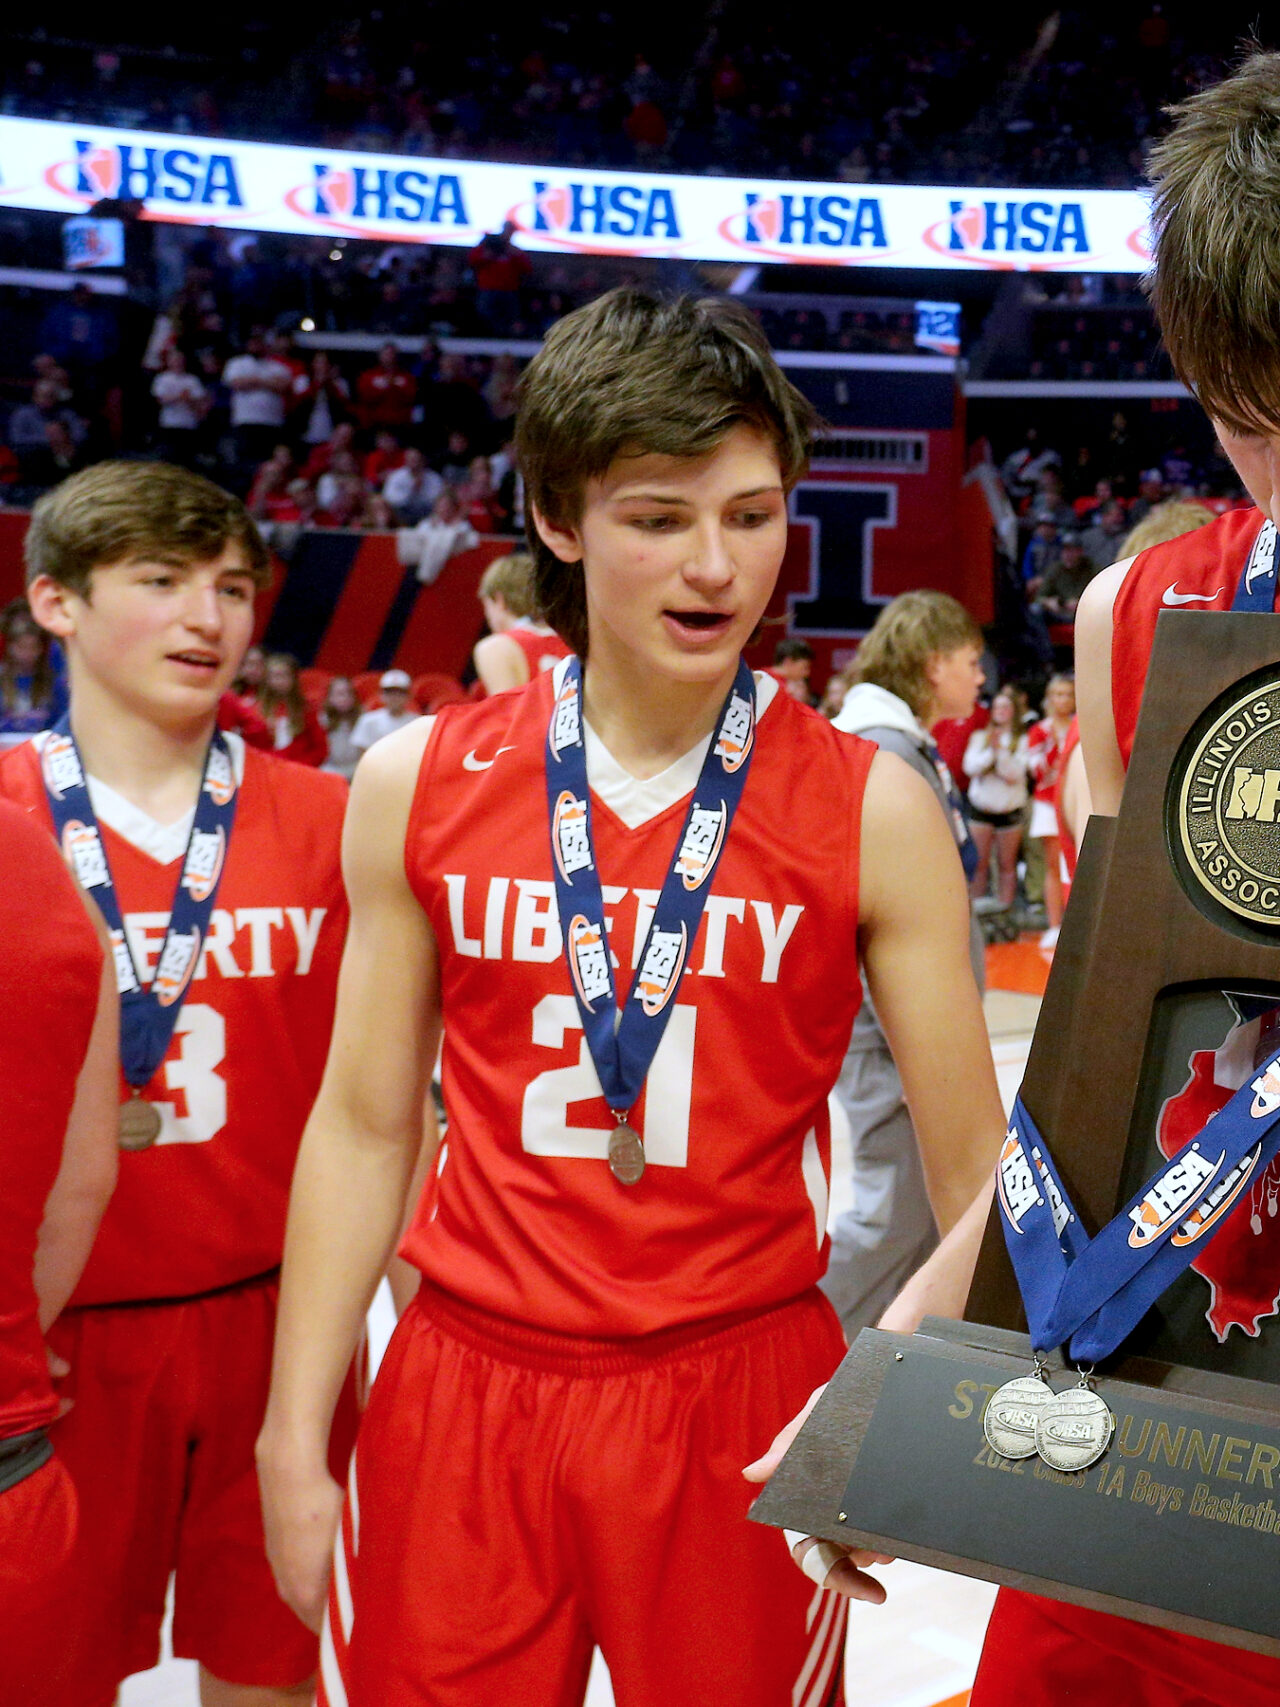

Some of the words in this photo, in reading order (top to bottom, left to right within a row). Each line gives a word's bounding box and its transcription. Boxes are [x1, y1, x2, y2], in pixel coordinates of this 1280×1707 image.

[74, 140, 245, 206] IHSA
[313, 164, 471, 226] IHSA
[532, 181, 682, 239] IHSA
[743, 192, 888, 248] IHSA
[947, 199, 1090, 255] IHSA
[1249, 519, 1279, 580] HSA
[713, 695, 751, 764] IHSA
[1192, 701, 1272, 813] ILLINOIS
[558, 799, 593, 876] IHSA
[674, 808, 722, 880] IHSA
[122, 907, 328, 983] ERTY
[572, 922, 611, 1003] IHSA
[633, 931, 683, 1006] IHSA
[154, 1003, 228, 1145] 3
[521, 993, 697, 1168] 21
[1000, 1126, 1042, 1221] IHSA
[1128, 1150, 1217, 1240] IHSA
[1096, 1462, 1126, 1498] 1A
[1130, 1469, 1184, 1515] Boys
